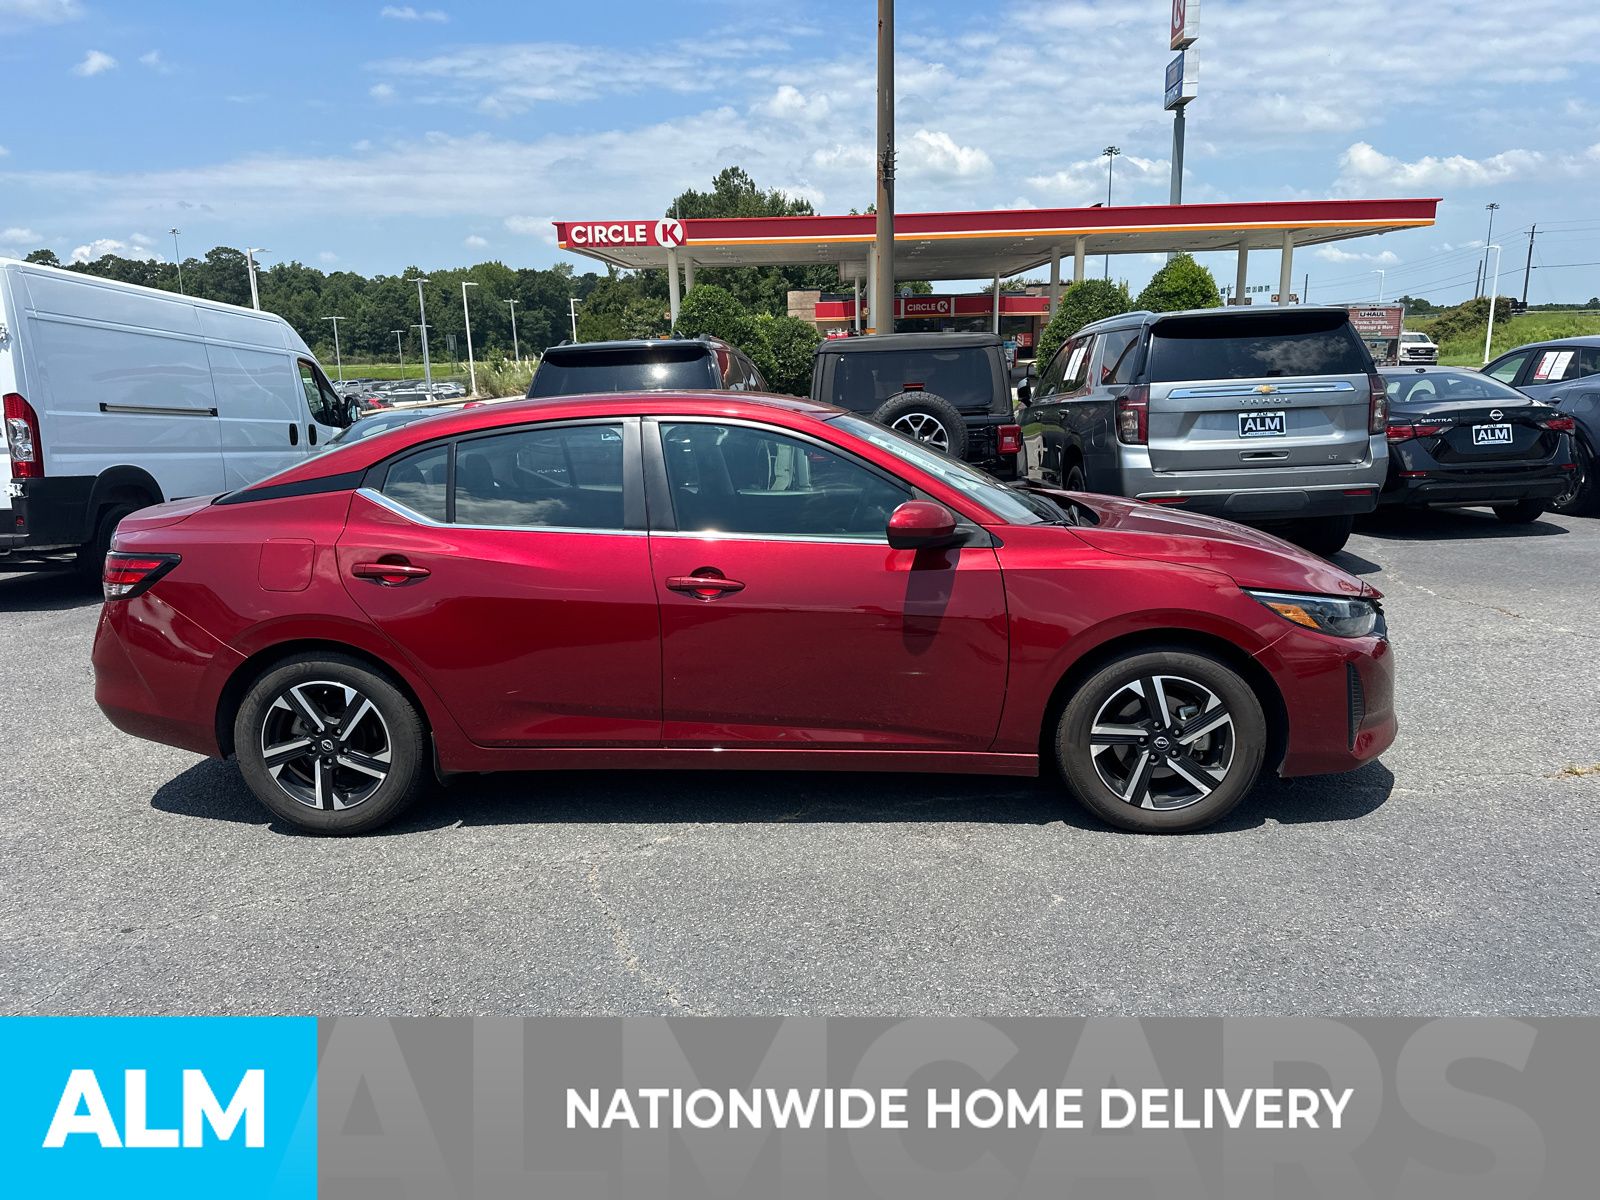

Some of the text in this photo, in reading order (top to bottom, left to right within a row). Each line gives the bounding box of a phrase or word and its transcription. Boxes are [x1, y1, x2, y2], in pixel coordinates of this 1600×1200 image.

[570, 223, 682, 246] CIRCLE K
[907, 303, 936, 311] CIRCLE
[1244, 417, 1281, 432] ALM
[1477, 428, 1508, 441] ALM
